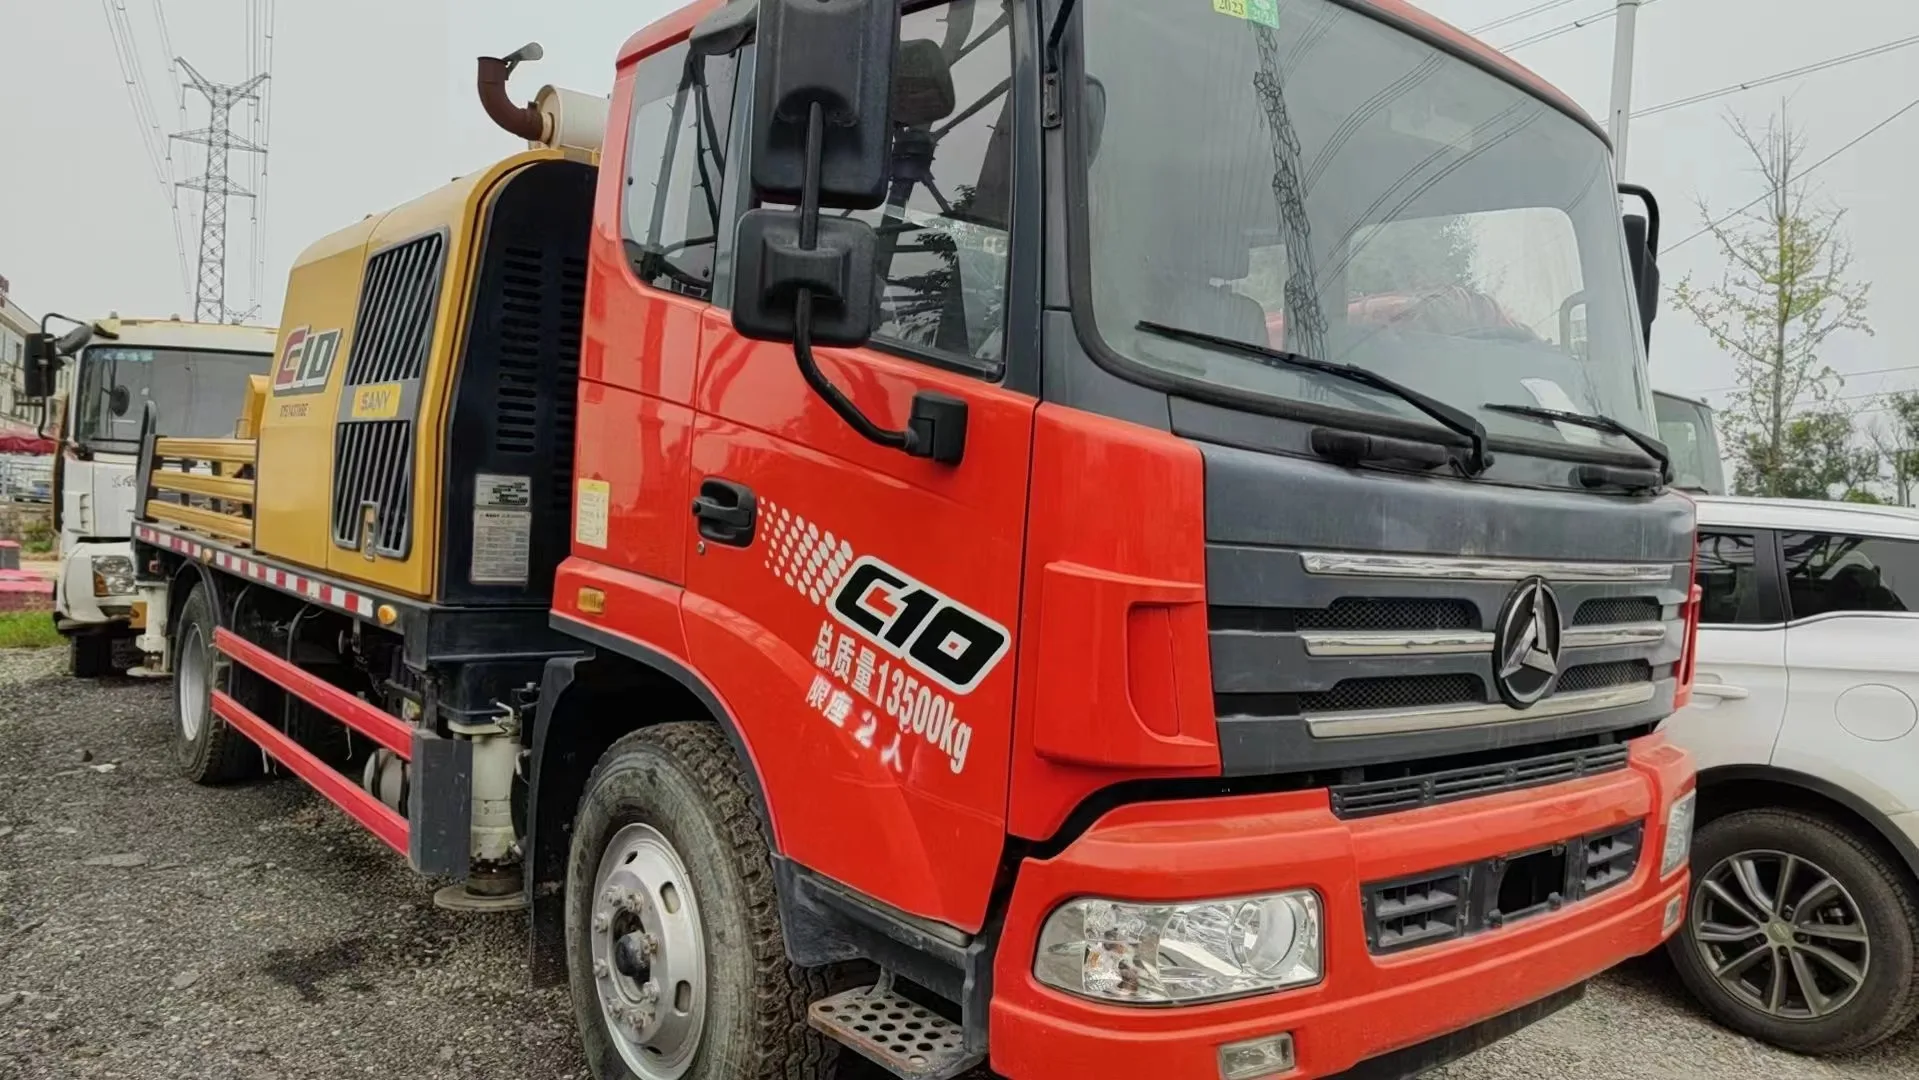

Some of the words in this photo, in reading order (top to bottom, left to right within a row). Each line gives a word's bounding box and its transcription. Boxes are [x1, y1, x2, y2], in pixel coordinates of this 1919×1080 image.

[1219, 0, 1245, 15] 2023
[360, 390, 392, 410] SANY
[832, 559, 1007, 689] C10
[811, 620, 973, 774] 总质量13500kg
